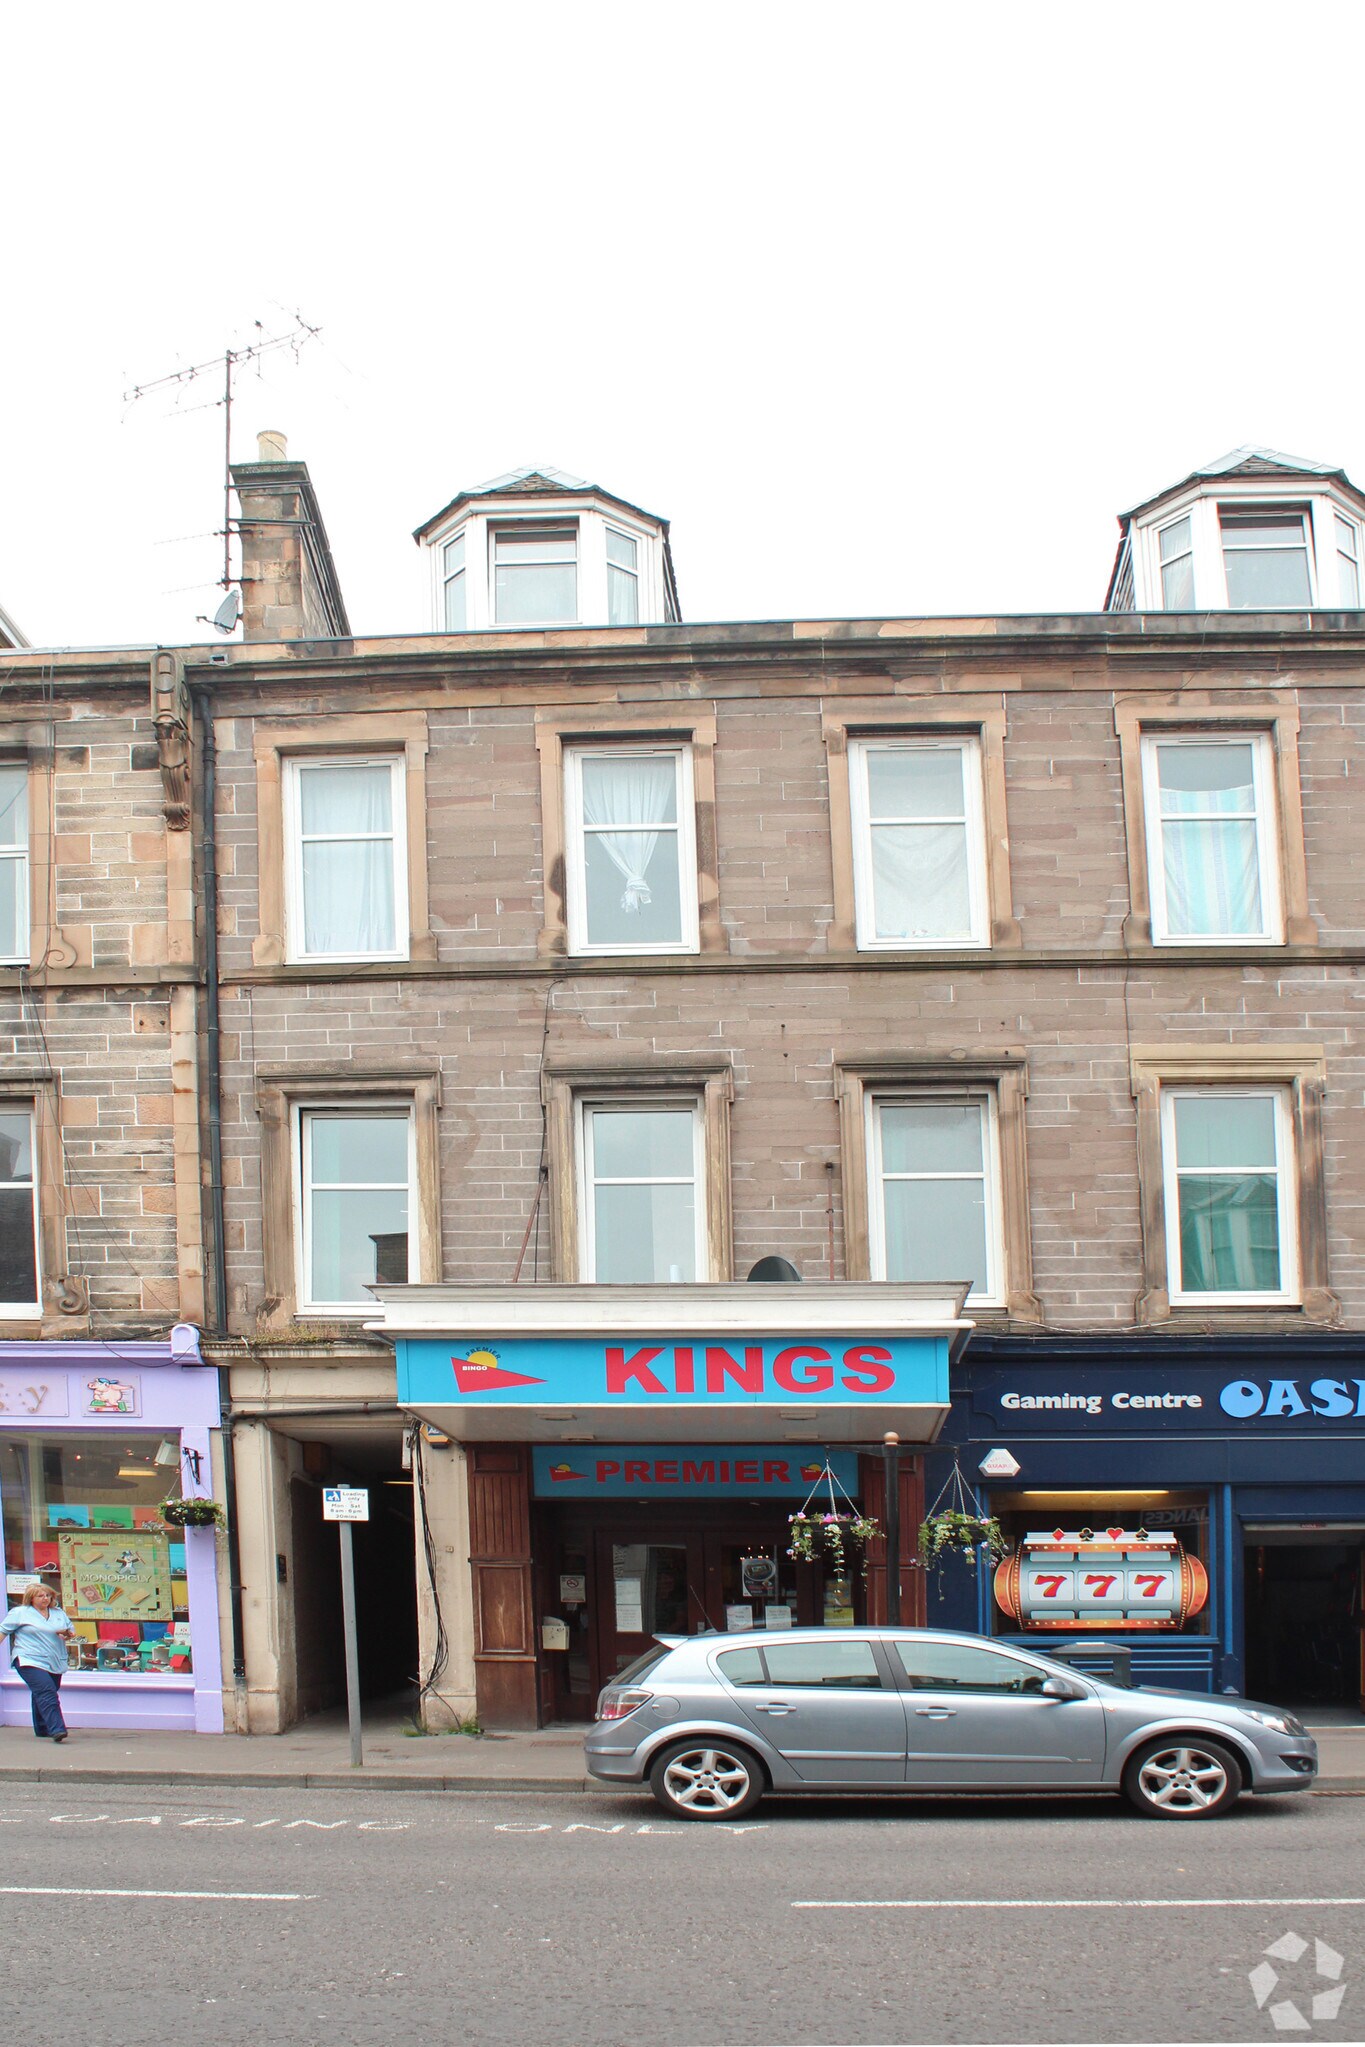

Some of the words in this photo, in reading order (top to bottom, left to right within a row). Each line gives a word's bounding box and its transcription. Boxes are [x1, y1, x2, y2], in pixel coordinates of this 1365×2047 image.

[465, 1346, 501, 1360] PREMIER
[605, 1345, 896, 1393] KINGS
[1000, 1392, 1102, 1414] Gaming
[1112, 1392, 1202, 1409] Centre
[595, 1460, 791, 1484] PREMIER
